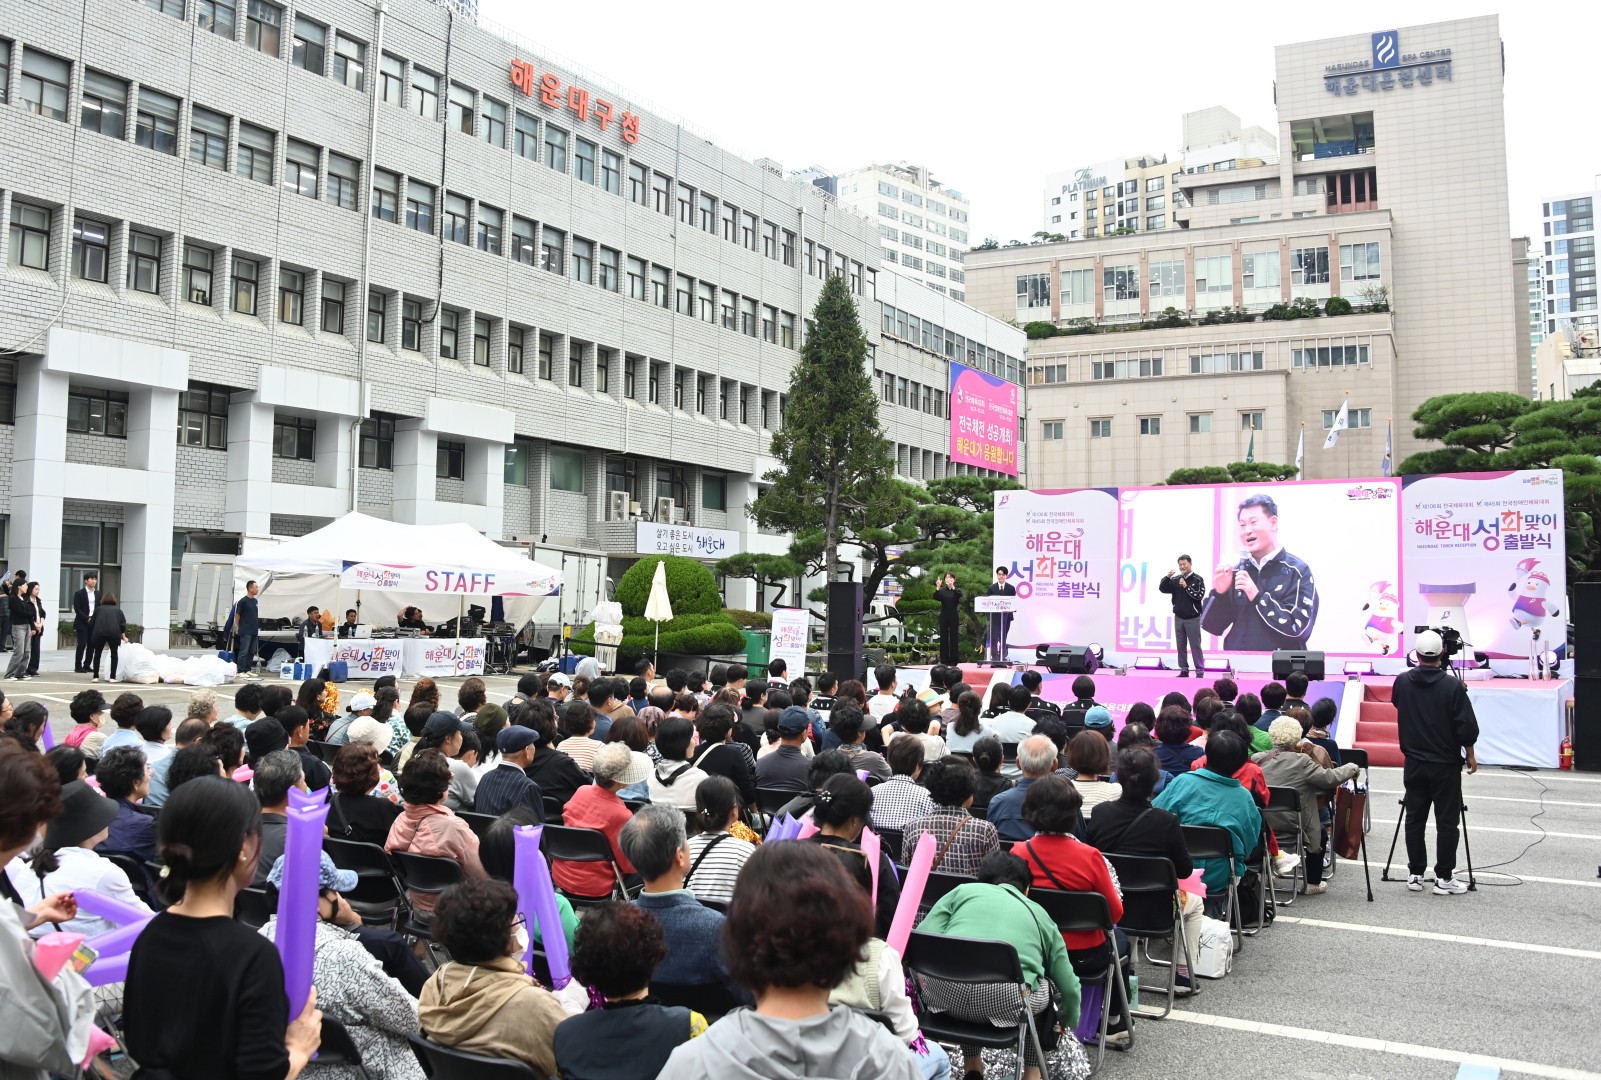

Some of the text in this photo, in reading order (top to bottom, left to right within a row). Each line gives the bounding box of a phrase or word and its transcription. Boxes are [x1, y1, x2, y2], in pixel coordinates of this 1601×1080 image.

[1325, 48, 1452, 72] HAEUNDAE SPA CENTER
[510, 58, 640, 144] 해운대구청
[1074, 165, 1094, 182] The
[1061, 176, 1107, 195] PLATINUM
[958, 415, 985, 439] 전국체전
[956, 436, 1015, 465] 해운대가 응원합니다
[656, 529, 694, 541] 살기 좋은 도시
[1415, 518, 1470, 541] 해운대
[656, 541, 668, 551] 오고
[682, 543, 694, 553] 도시
[696, 534, 725, 554] 해운대
[1025, 531, 1081, 560] 해운대
[1503, 533, 1552, 550] 출발식
[425, 570, 496, 593] STAFF
[1007, 554, 1088, 599] 성화맞이
[1057, 581, 1100, 599] 출발식
[358, 646, 400, 671] 성화맞이
[425, 648, 452, 663] 해운대
[371, 661, 396, 672] 출발식
